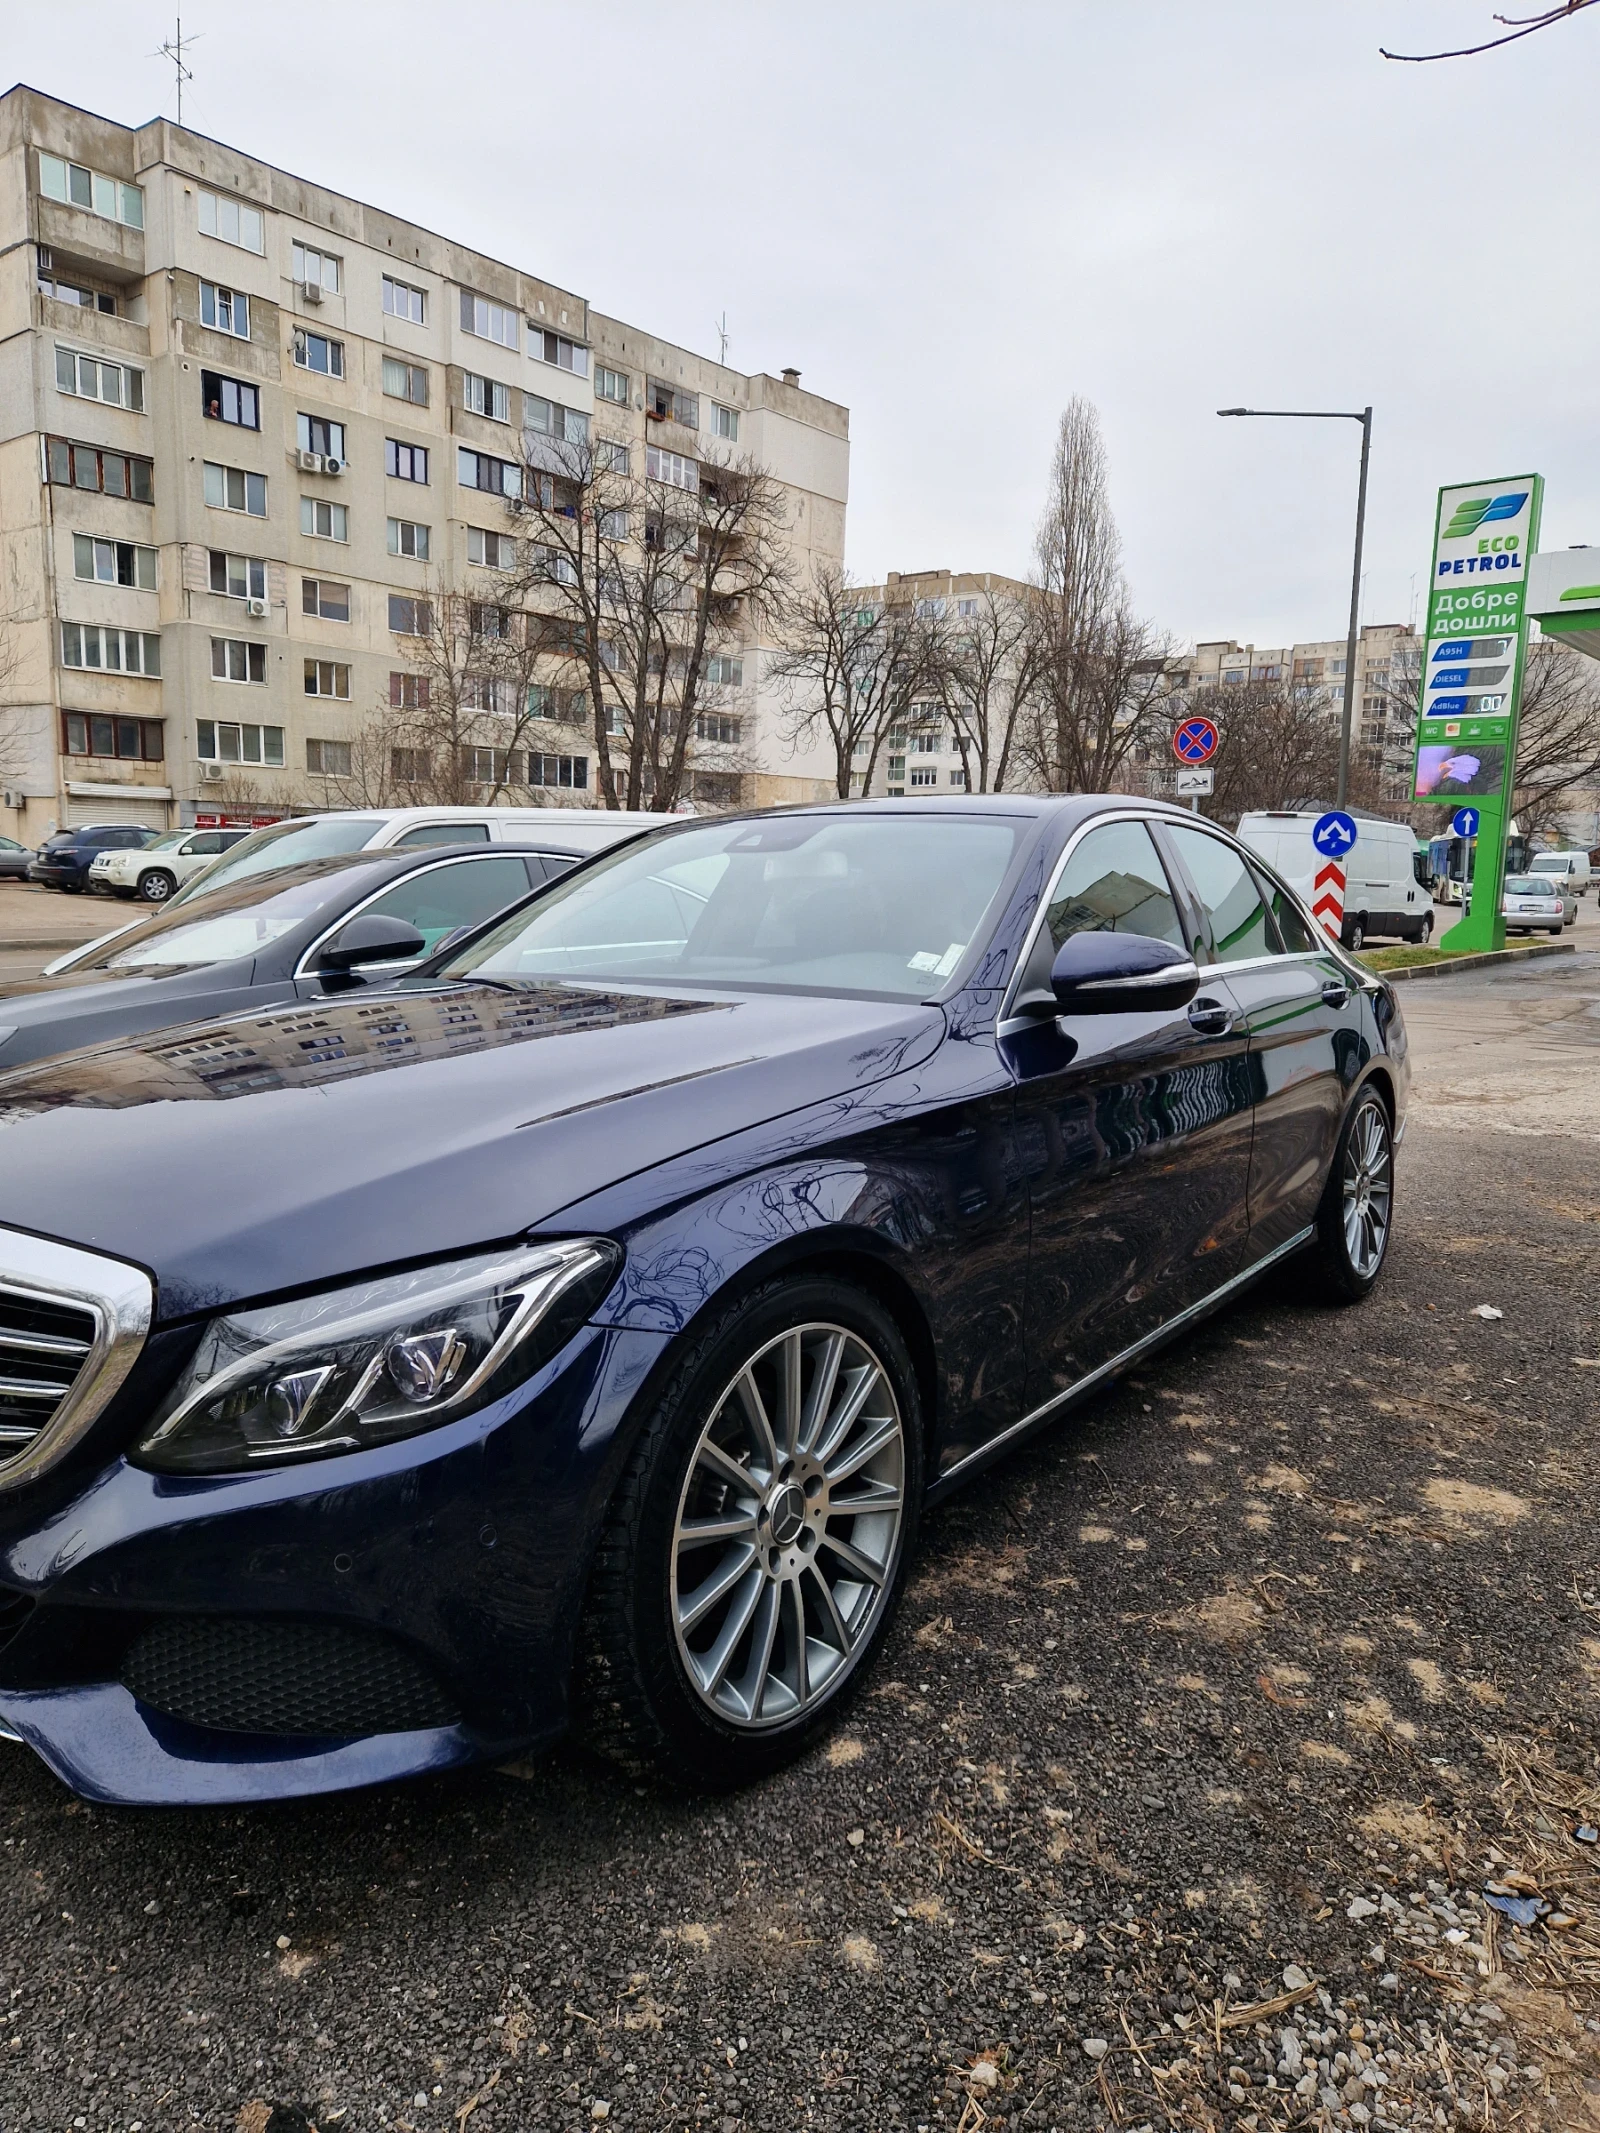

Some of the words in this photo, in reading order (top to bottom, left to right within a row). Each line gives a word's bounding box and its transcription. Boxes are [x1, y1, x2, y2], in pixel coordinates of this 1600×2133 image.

[1478, 535, 1520, 554] ECO
[1438, 553, 1522, 576] PETROL
[1434, 590, 1518, 615] Добре
[1433, 613, 1517, 634] дошли
[1438, 647, 1463, 656] A95H
[1435, 675, 1463, 683] DIESEL
[1431, 702, 1460, 711] AdBlue
[1425, 727, 1438, 735] WC
